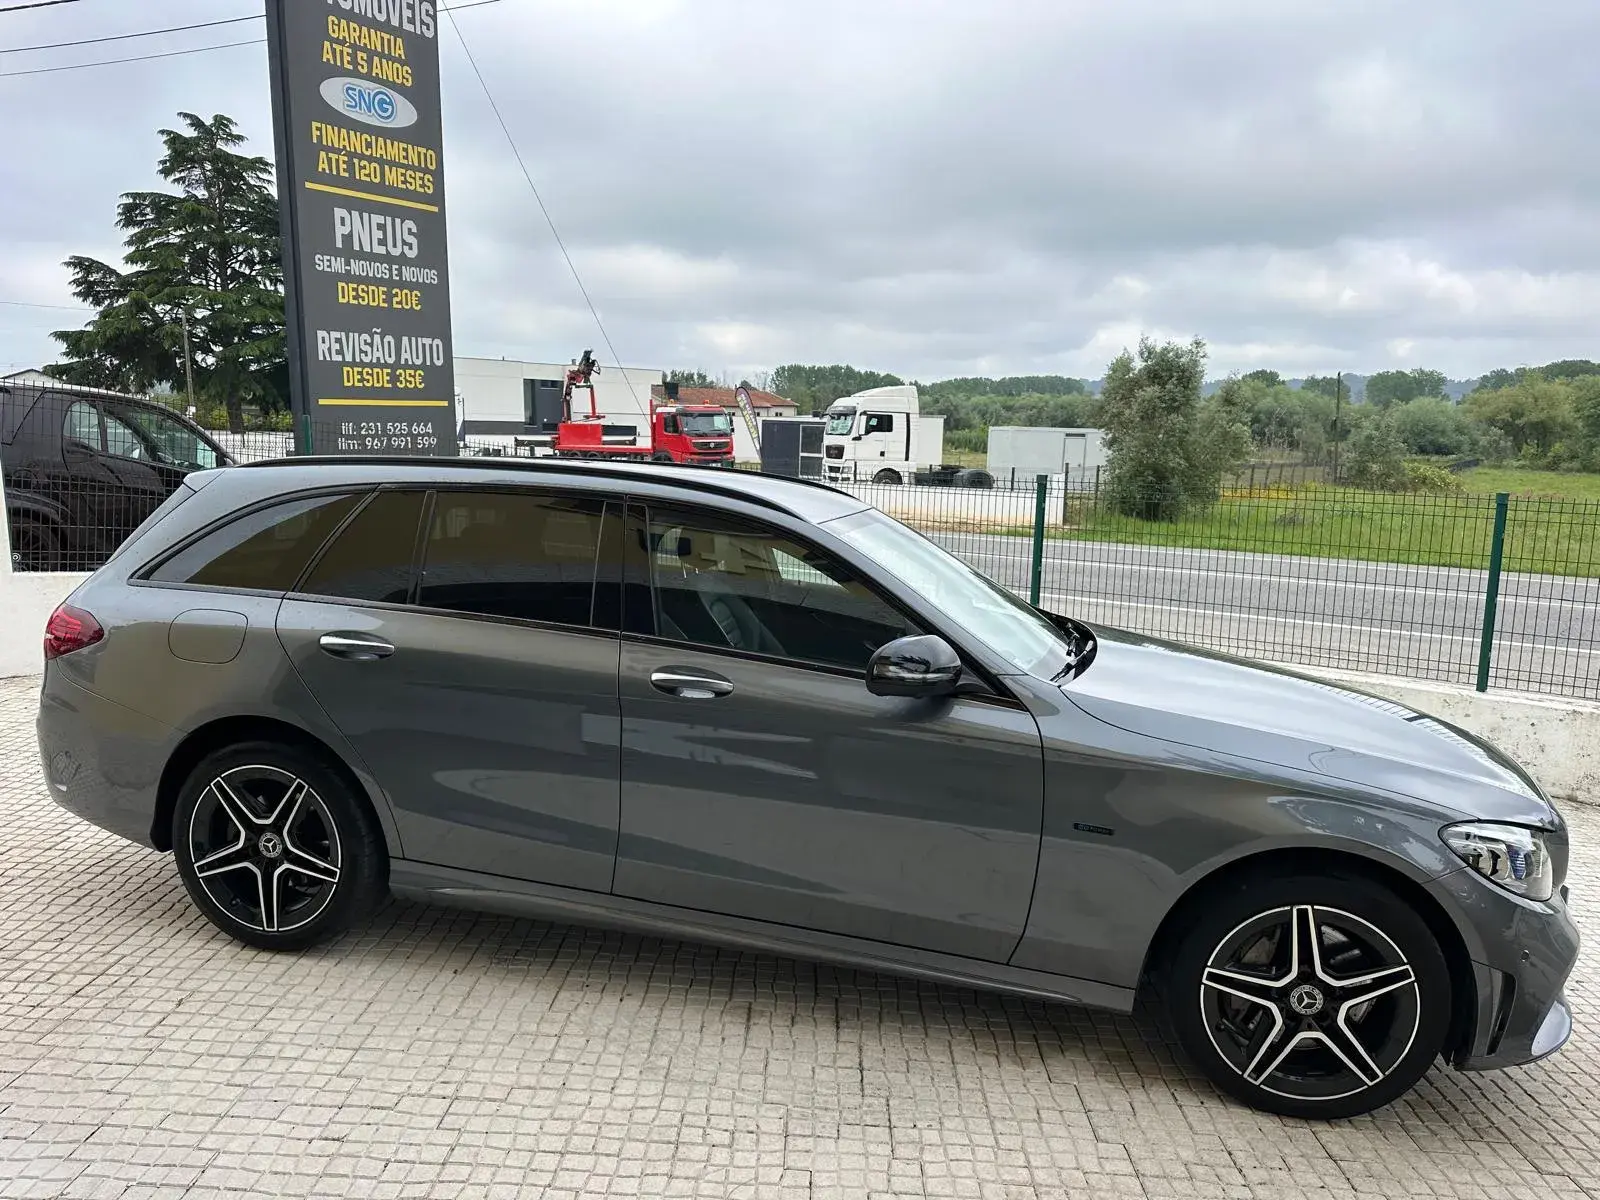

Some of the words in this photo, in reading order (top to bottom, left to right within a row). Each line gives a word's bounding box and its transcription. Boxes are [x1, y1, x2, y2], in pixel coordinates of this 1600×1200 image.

[328, 15, 405, 59] GARANTIA
[322, 41, 353, 70] ATÉ
[356, 52, 368, 74] 5
[372, 57, 413, 87] ANOS
[343, 83, 397, 123] SNG
[311, 121, 436, 170] FINANCIAMENTO
[318, 151, 349, 177] ATÉ
[353, 157, 380, 184] 120
[385, 166, 434, 194] MESES
[333, 207, 418, 259] PNEUS
[314, 254, 390, 280] SEMI-NOVOS
[392, 265, 399, 280] E
[402, 265, 438, 285] NOVOS
[338, 282, 388, 308] DESDE
[392, 288, 422, 311] 20€
[316, 328, 396, 364] REVISÃO
[401, 336, 444, 367] AUTO
[342, 367, 392, 388] DESDE
[396, 369, 425, 389] 35€
[360, 422, 382, 435] 231
[386, 422, 409, 435] 525
[411, 422, 433, 434] 664
[365, 437, 387, 450] 967
[391, 436, 412, 449] 991
[417, 436, 437, 449] 599
